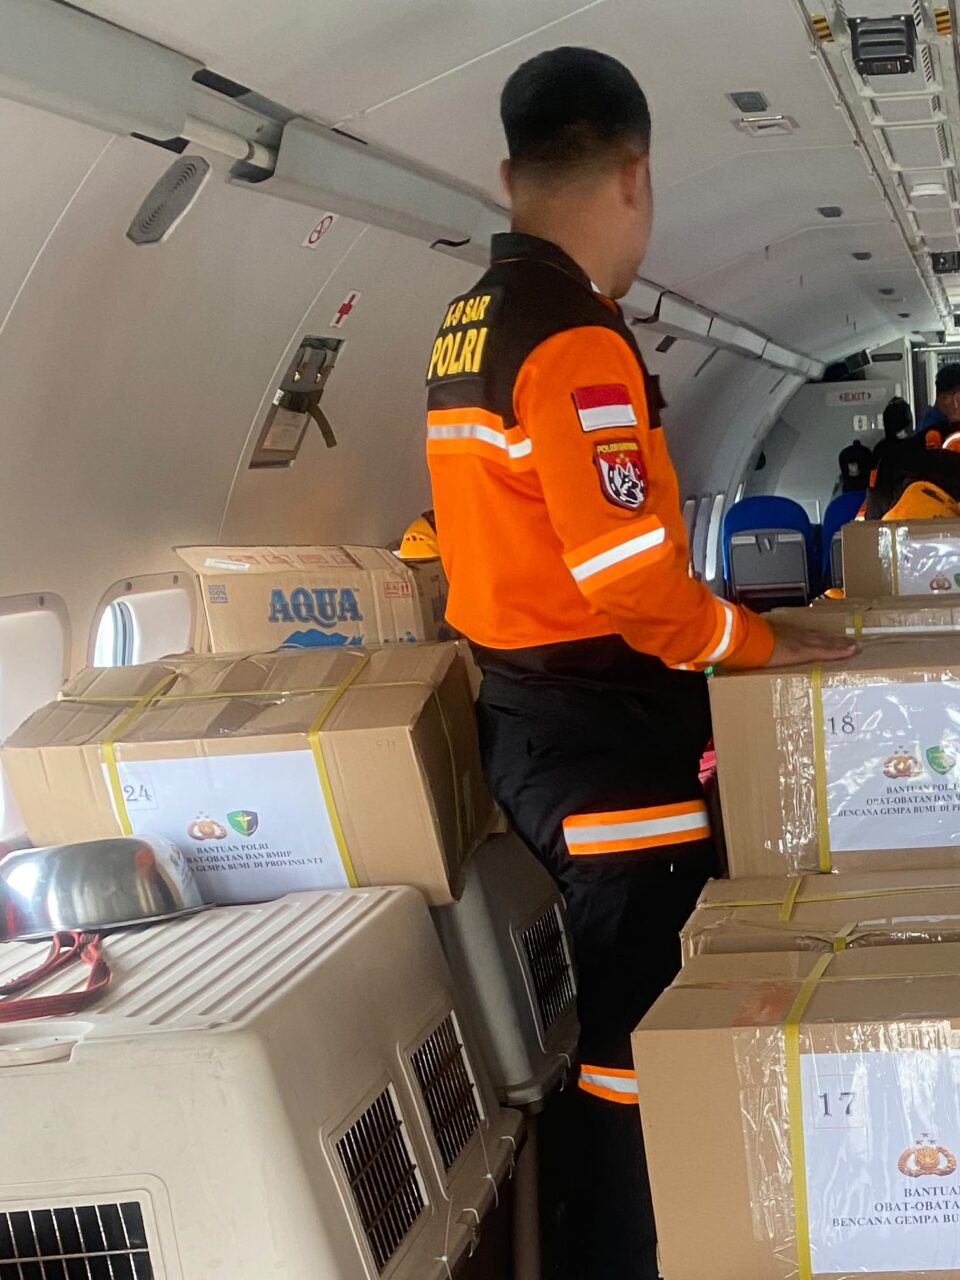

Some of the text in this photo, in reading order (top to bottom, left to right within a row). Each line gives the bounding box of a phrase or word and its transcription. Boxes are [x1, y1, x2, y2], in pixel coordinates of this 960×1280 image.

[427, 327, 488, 380] POLRI
[844, 391, 865, 402] EXIT
[268, 587, 363, 628] AQUA
[827, 714, 855, 736] 18
[124, 784, 152, 802] 24
[934, 793, 953, 803] DAN
[880, 806, 911, 816] GEMPA
[913, 804, 936, 814] BUMI
[940, 804, 949, 812] DI
[196, 842, 269, 854] BANTUAN POLRI
[186, 853, 243, 864] BAT-OBATAN
[245, 852, 264, 861] DAN
[196, 863, 226, 873] GEMPA
[227, 861, 250, 871] BUMI
[254, 860, 263, 869] DI
[265, 859, 304, 869] PROVINSI
[304, 857, 324, 865] NTT
[818, 1091, 856, 1117] 17
[832, 1216, 892, 1228] BENCANA
[894, 1213, 939, 1226] GEMPA
